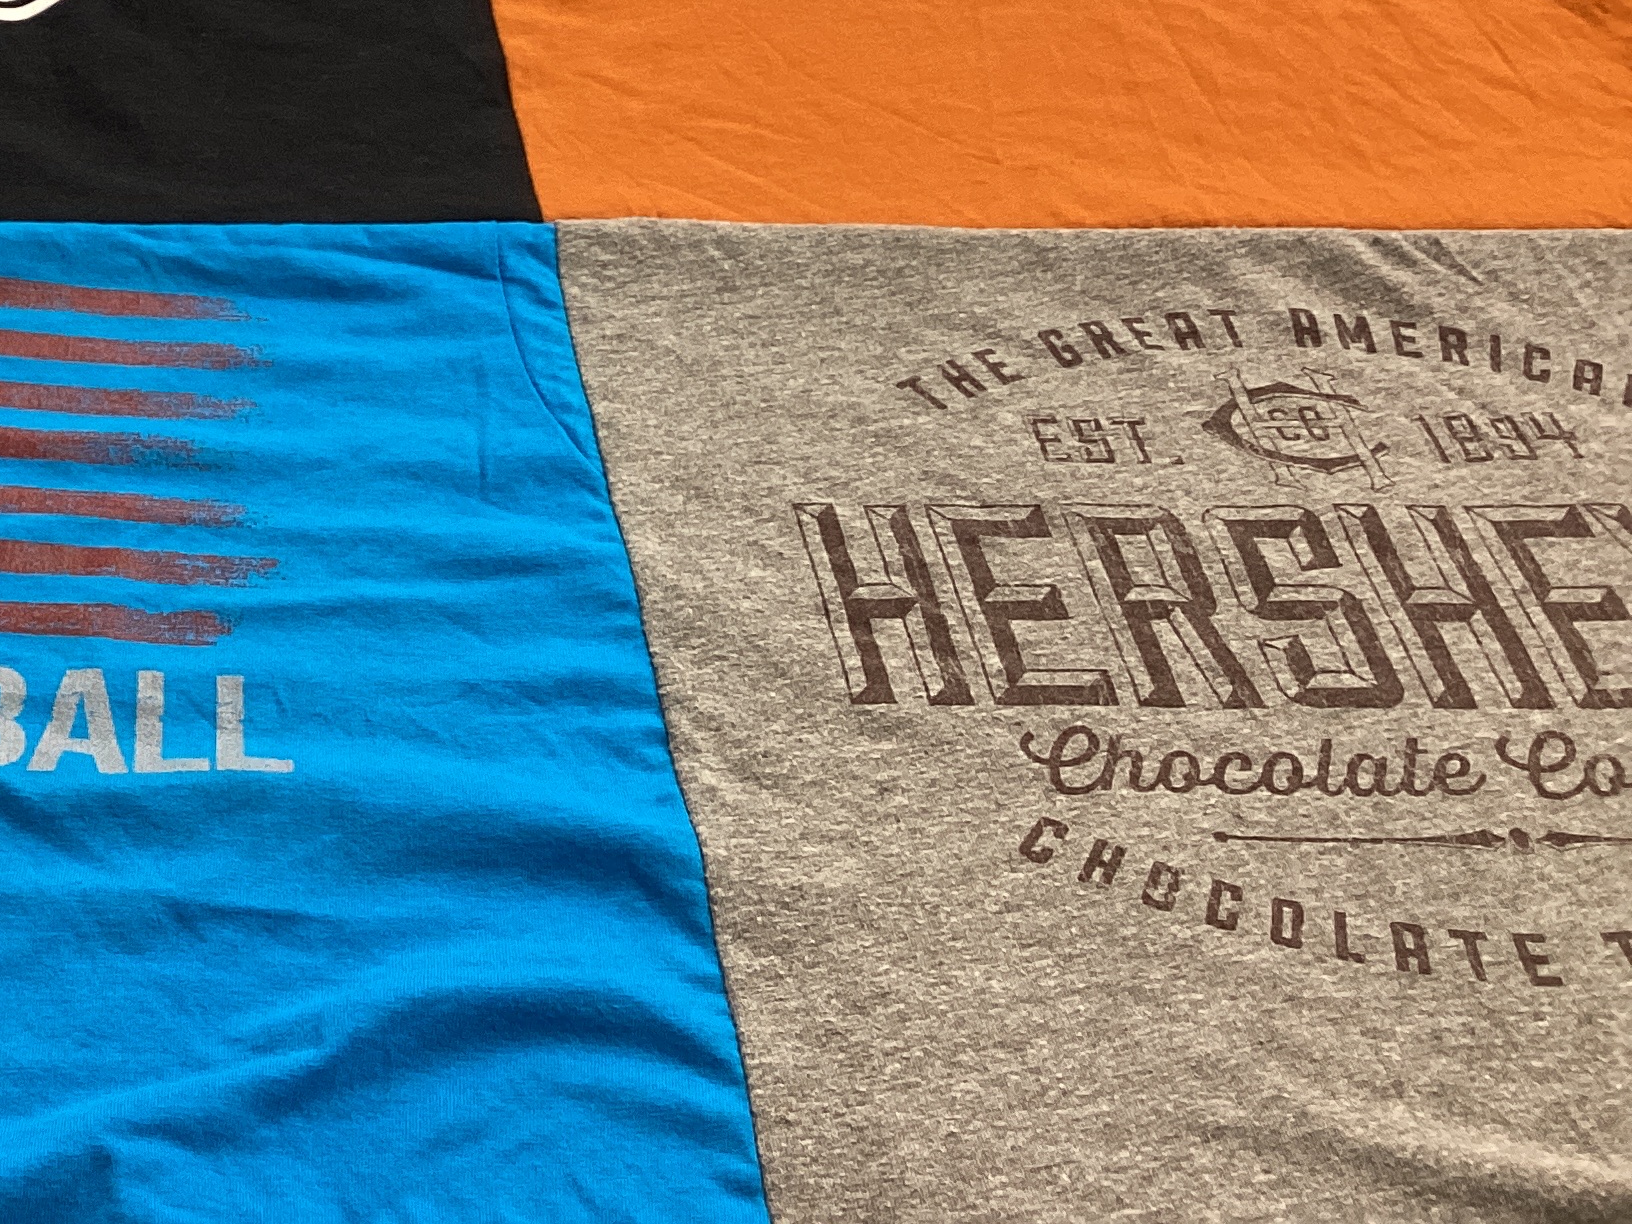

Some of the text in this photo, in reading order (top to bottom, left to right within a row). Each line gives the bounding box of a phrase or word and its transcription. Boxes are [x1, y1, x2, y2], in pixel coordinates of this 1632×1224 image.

[895, 307, 1632, 411] THE GREAT AMERICA
[1020, 725, 1487, 797] Chocolate
[1018, 816, 1566, 988] CHOCOLATE
